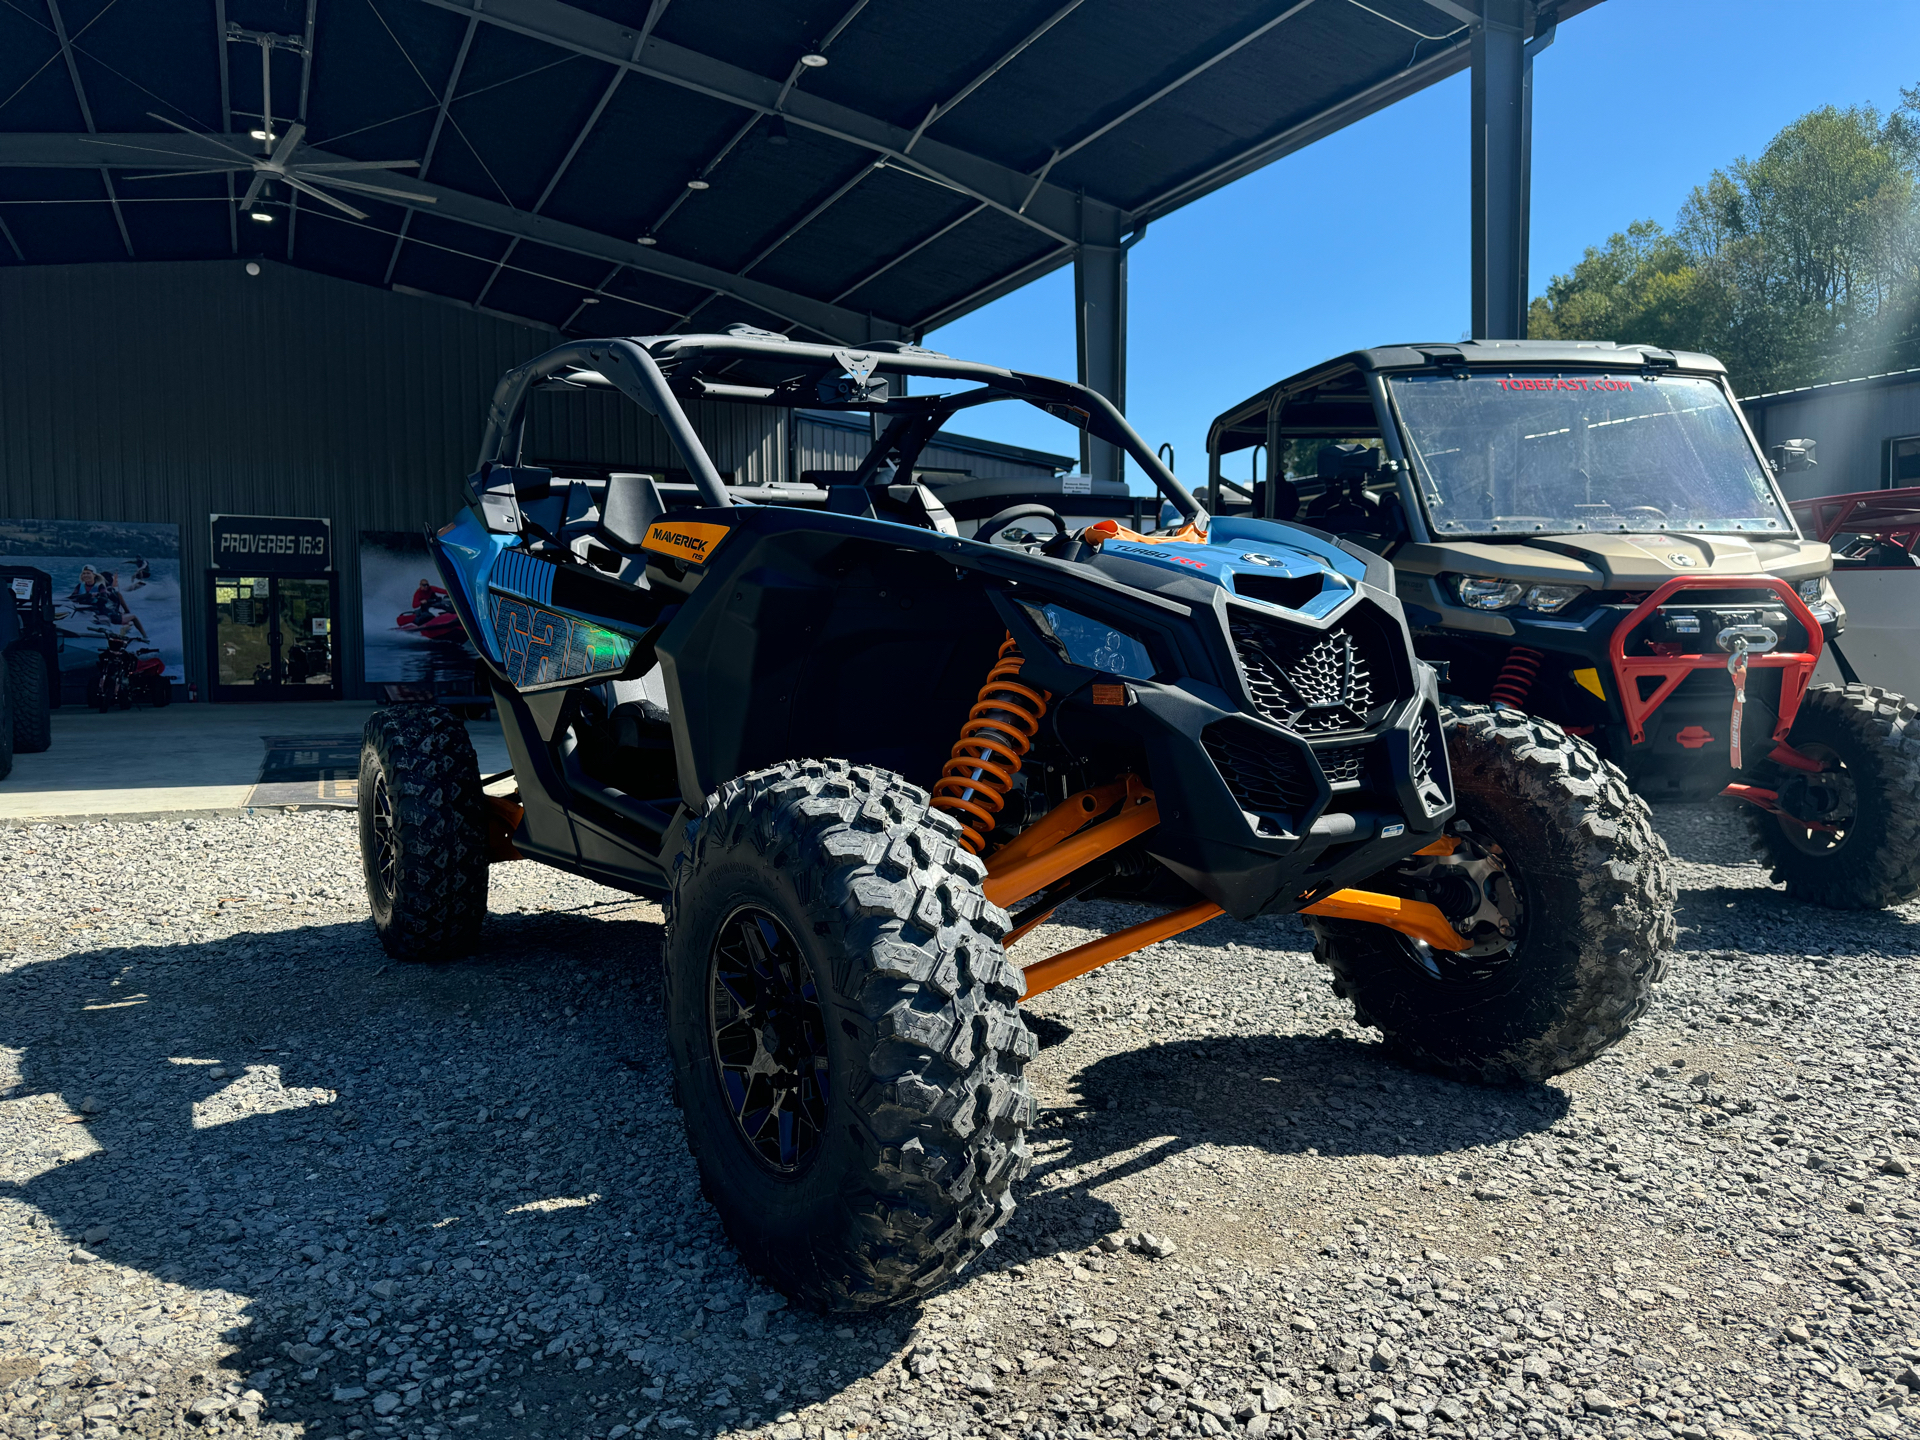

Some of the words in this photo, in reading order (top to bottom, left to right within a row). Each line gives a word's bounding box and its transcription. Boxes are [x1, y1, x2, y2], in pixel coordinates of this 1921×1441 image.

[1496, 379, 1634, 392] TOBEFAST.COM
[220, 533, 296, 554] PROVERBS
[298, 535, 325, 555] 16:3
[652, 527, 709, 553] MAVERICK
[691, 552, 704, 561] RS
[1113, 544, 1172, 559] TURBO
[1732, 709, 1741, 749] can-am
